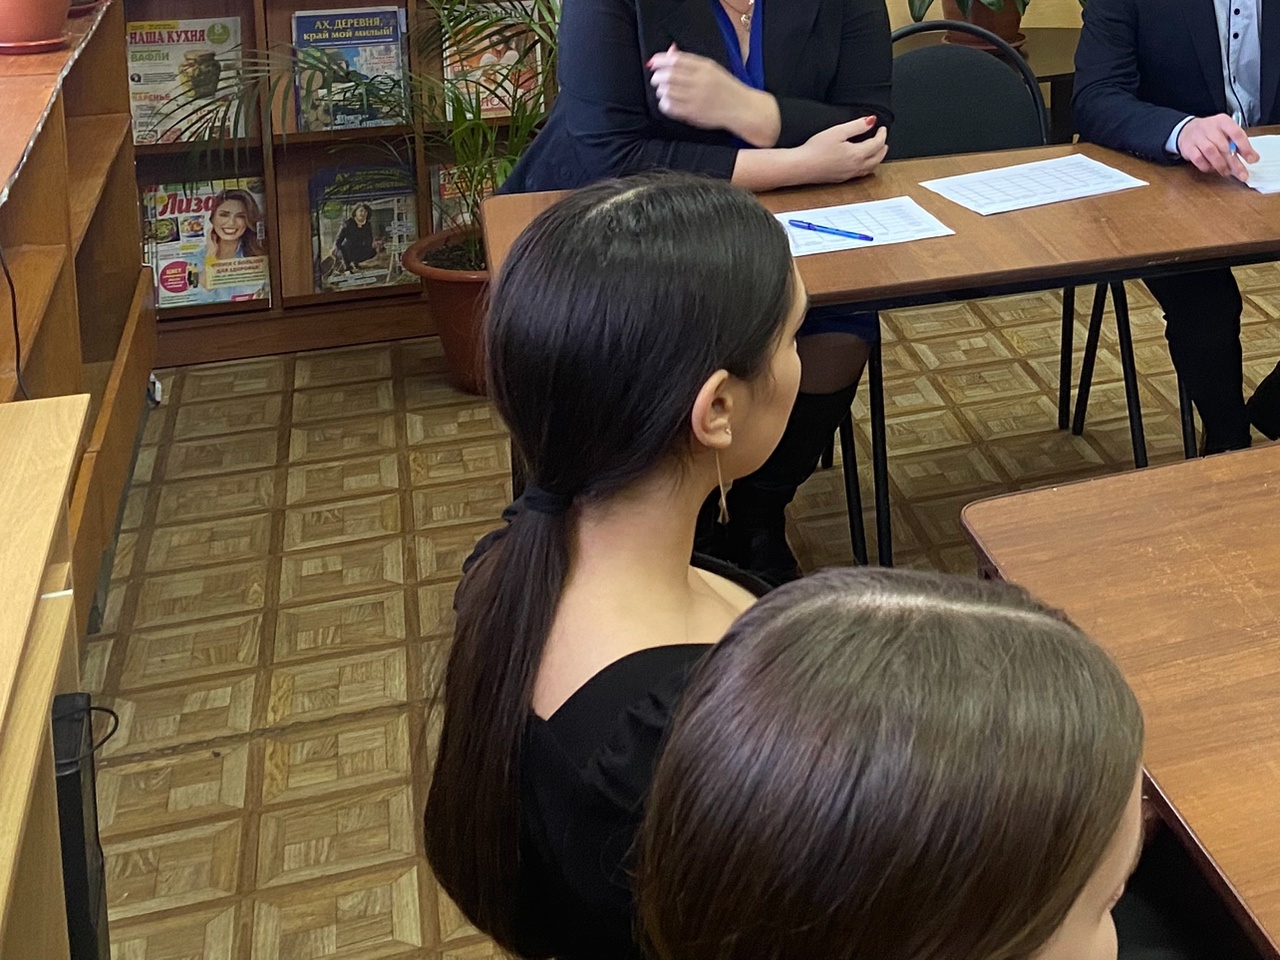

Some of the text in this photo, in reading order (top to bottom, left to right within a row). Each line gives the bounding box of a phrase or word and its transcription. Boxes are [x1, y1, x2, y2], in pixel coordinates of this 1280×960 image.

[303, 32, 329, 42] край
[331, 29, 353, 38] мой
[158, 192, 221, 217] Лиза
